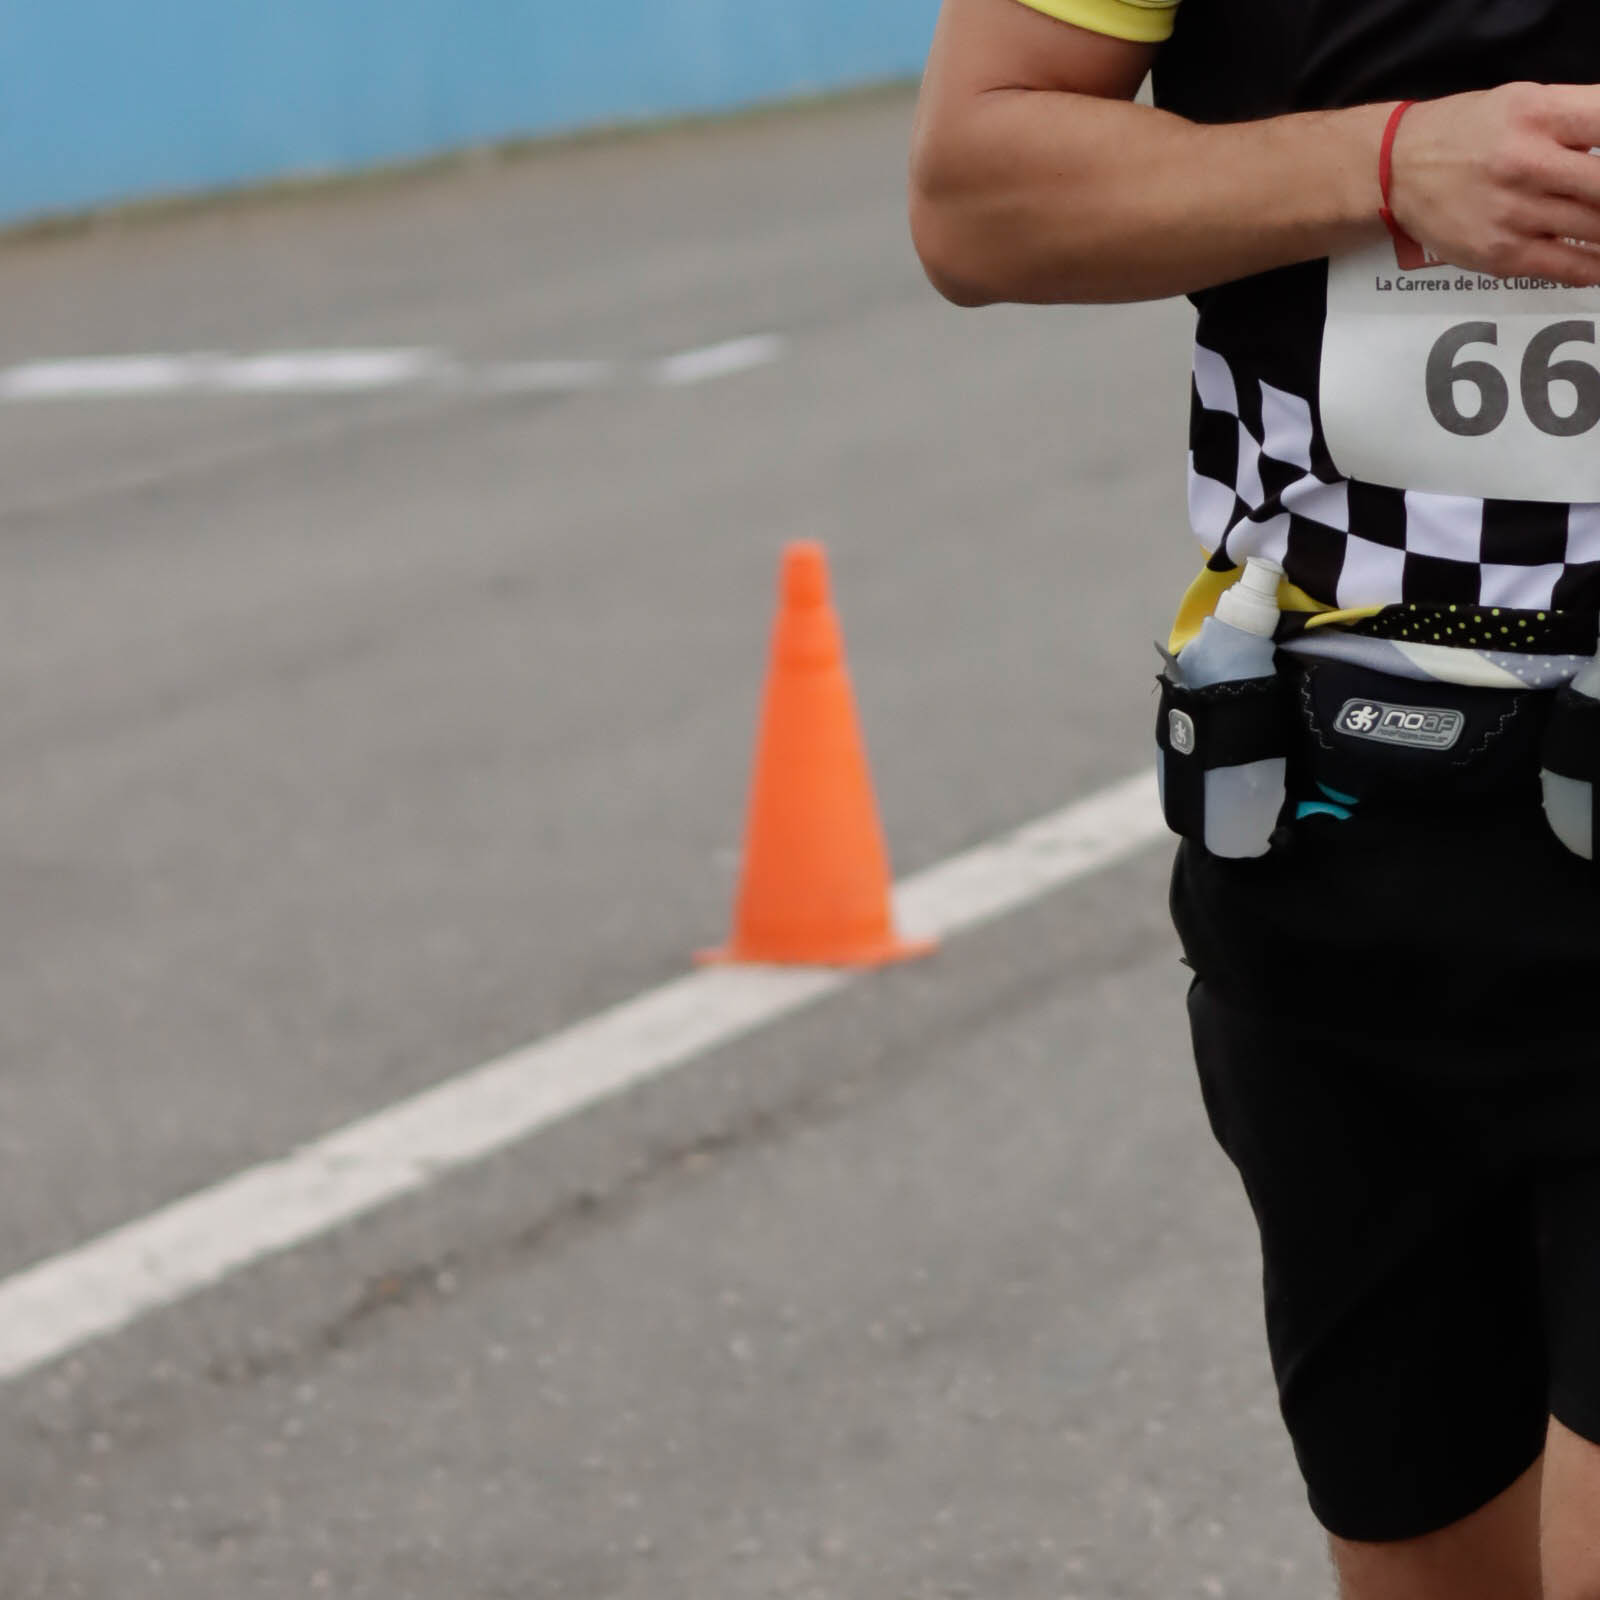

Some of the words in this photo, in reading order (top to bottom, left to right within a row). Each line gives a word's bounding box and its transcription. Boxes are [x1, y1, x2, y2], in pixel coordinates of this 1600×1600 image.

[1375, 276, 1392, 291] La
[1396, 276, 1450, 292] Carrera
[1454, 275, 1473, 291] de
[1477, 275, 1499, 290] los
[1504, 276, 1557, 290] Clubes
